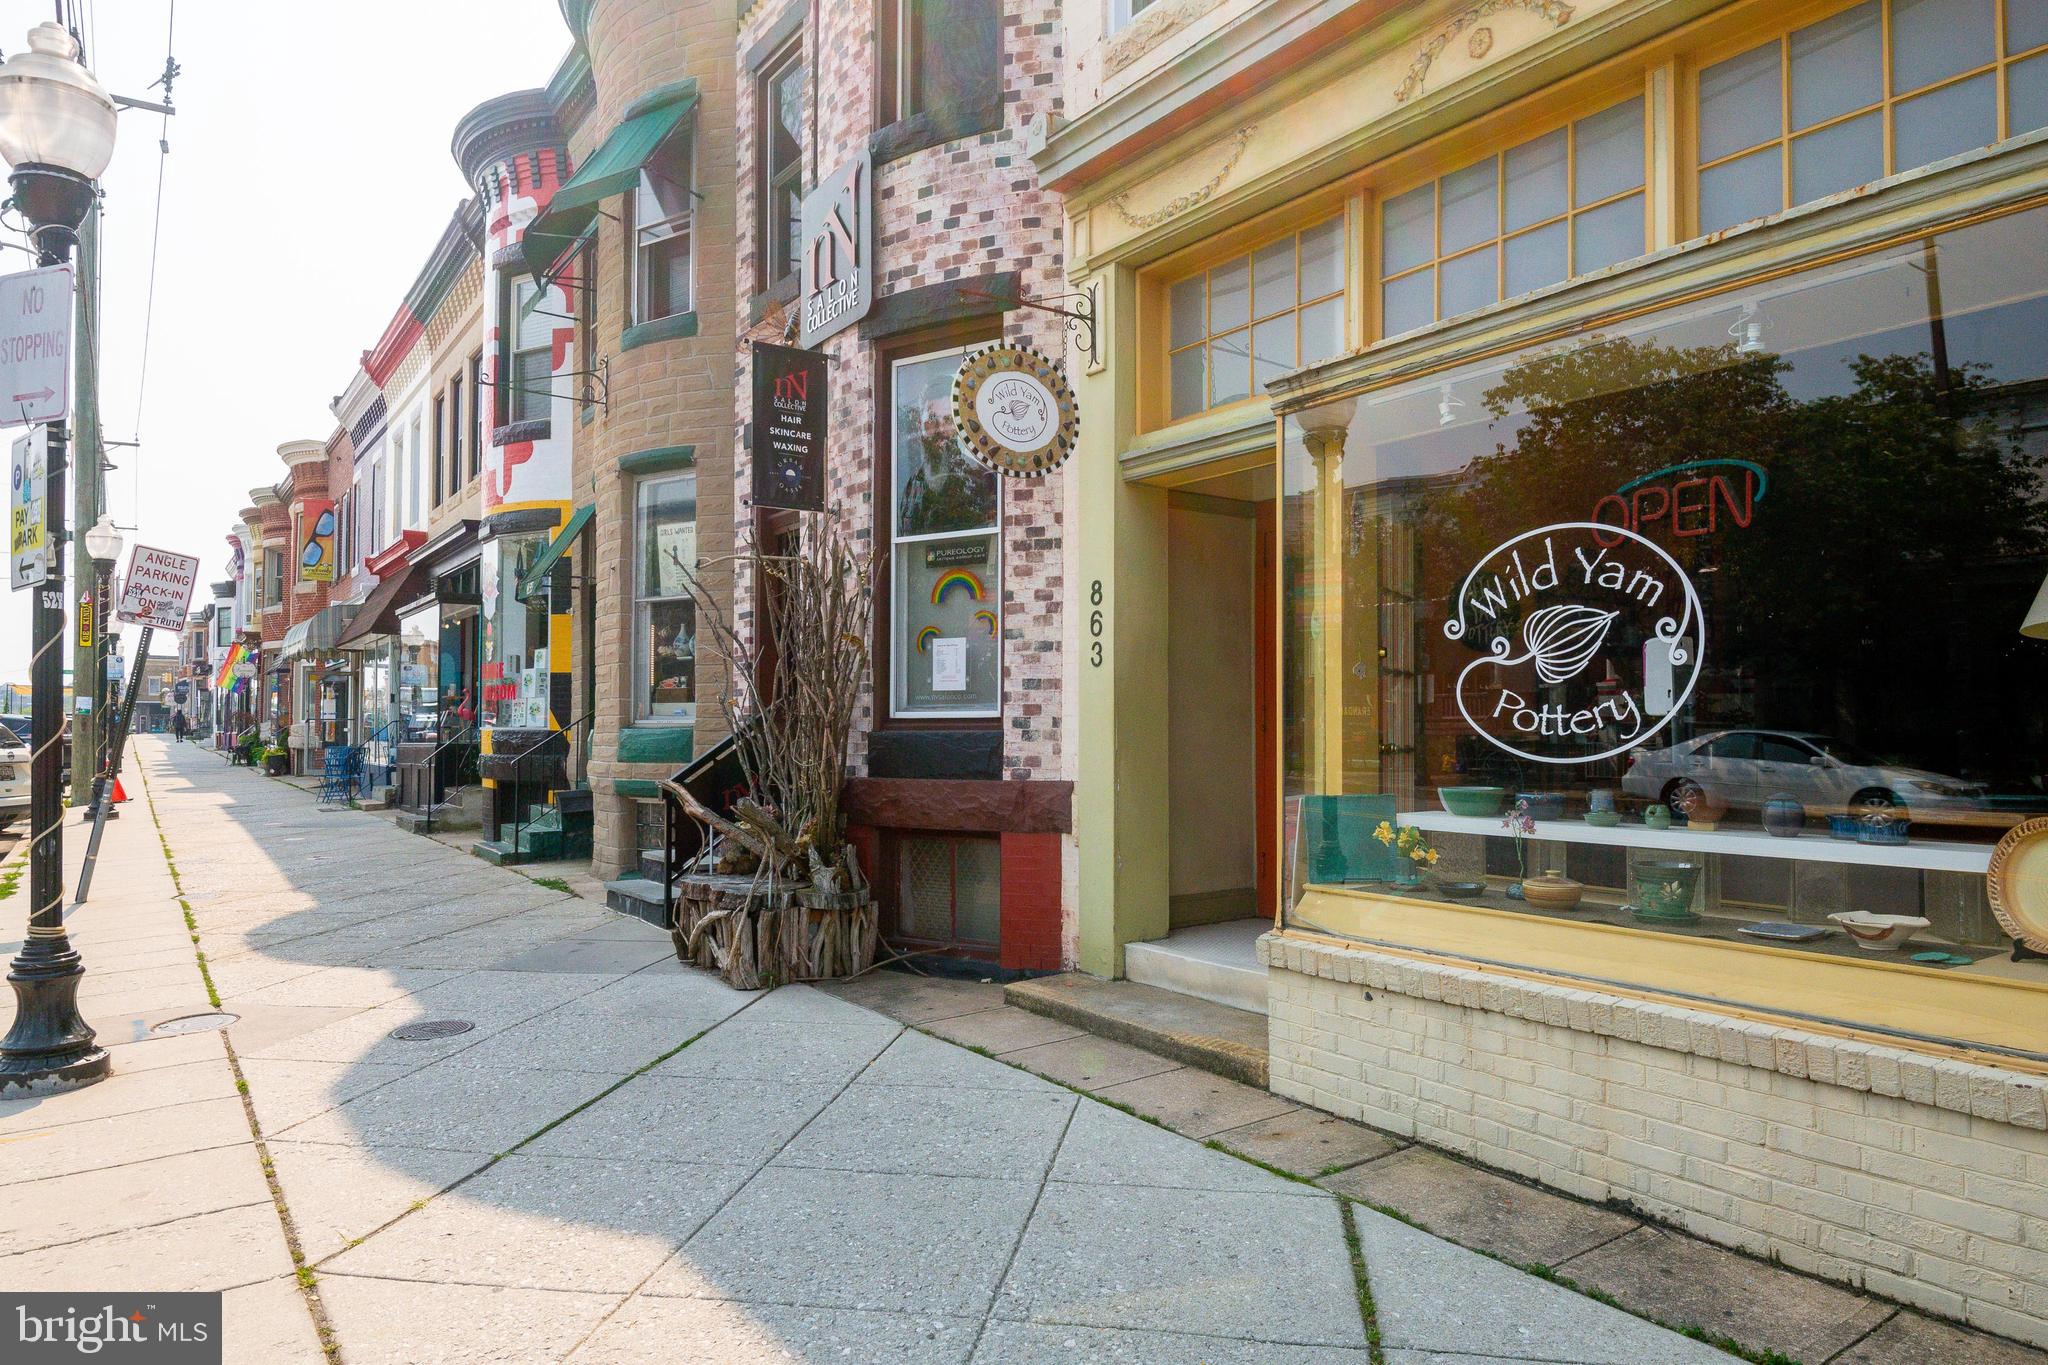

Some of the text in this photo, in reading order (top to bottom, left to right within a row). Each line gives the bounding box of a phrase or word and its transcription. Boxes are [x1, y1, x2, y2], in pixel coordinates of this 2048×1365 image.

[22, 285, 45, 315] NO
[807, 269, 858, 317] SALON
[807, 288, 858, 333] COLLECTIVE
[0, 330, 65, 364] STOPPING
[773, 396, 807, 407] SALON
[995, 382, 1040, 405] Wild Yam
[773, 401, 807, 412] COLLECTIVE
[780, 414, 802, 425] HAIR
[1002, 420, 1037, 437] Pottery
[769, 426, 812, 440] SKINCARE
[772, 441, 809, 453] WAXING
[15, 505, 30, 528] PAY
[1591, 470, 1753, 548] OPEN
[145, 553, 187, 570] ANGLE
[936, 545, 985, 557] PUREOLOGY
[135, 565, 190, 586] PARKING
[1470, 537, 1559, 618] Wild
[1575, 546, 1664, 607] Yam
[155, 617, 181, 629] TRUTH
[1493, 689, 1641, 738] Pottery
